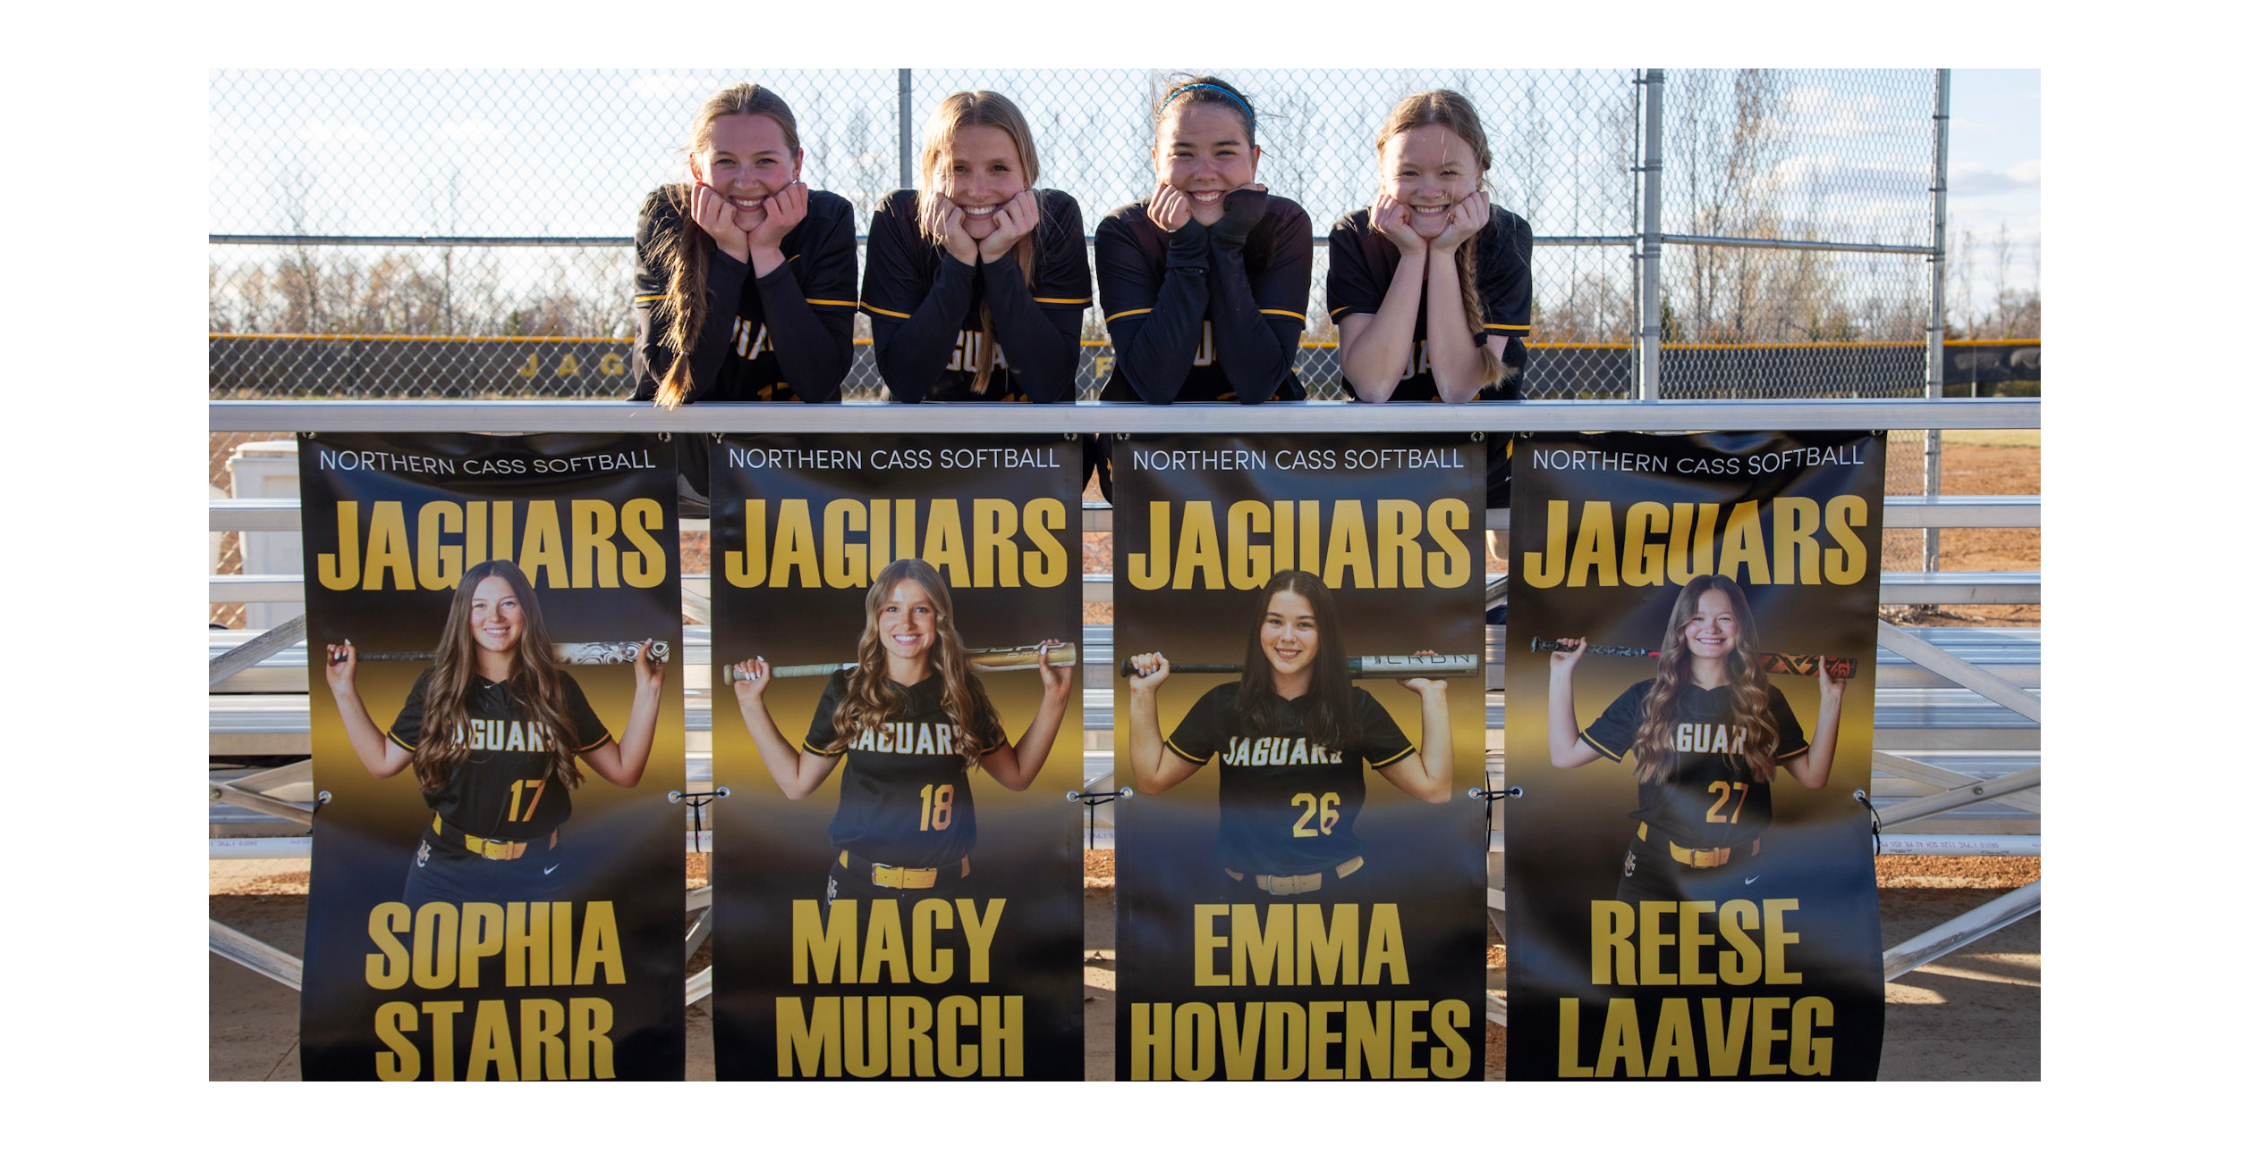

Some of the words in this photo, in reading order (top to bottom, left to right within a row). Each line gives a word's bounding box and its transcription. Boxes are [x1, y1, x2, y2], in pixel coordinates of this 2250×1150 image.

[319, 450, 455, 474] NORTHERN
[463, 459, 527, 474] CASS
[533, 449, 656, 473] SOFTBALL
[729, 448, 862, 470] NORTHERN
[871, 449, 932, 470] CASS
[940, 447, 1060, 469] SOFTBALL
[1133, 450, 1267, 471] NORTHERN
[1274, 450, 1337, 471] CASS
[1344, 448, 1464, 470] SOFTBALL
[1533, 449, 1668, 473] NORTHERN
[1677, 457, 1740, 476] CASS
[1748, 445, 1864, 475] SOFTBALL
[318, 497, 667, 591] JAGUARS
[724, 497, 1068, 590] JAGUARS
[1127, 497, 1472, 591] JAGUARS
[1523, 494, 1868, 589] JAGUARS
[508, 779, 547, 822] 17
[919, 783, 954, 832] 18
[1291, 792, 1341, 838] 26
[1706, 780, 1749, 824] 27
[365, 900, 626, 990] SOPHIA
[792, 898, 1007, 985] MACY
[1194, 903, 1411, 987] EMMA
[1590, 898, 1802, 986] REESE
[375, 997, 616, 1081] STARR
[775, 995, 1024, 1078] MURCH
[1131, 998, 1472, 1081] HOVDENES
[1558, 996, 1834, 1078] LAAVEG
